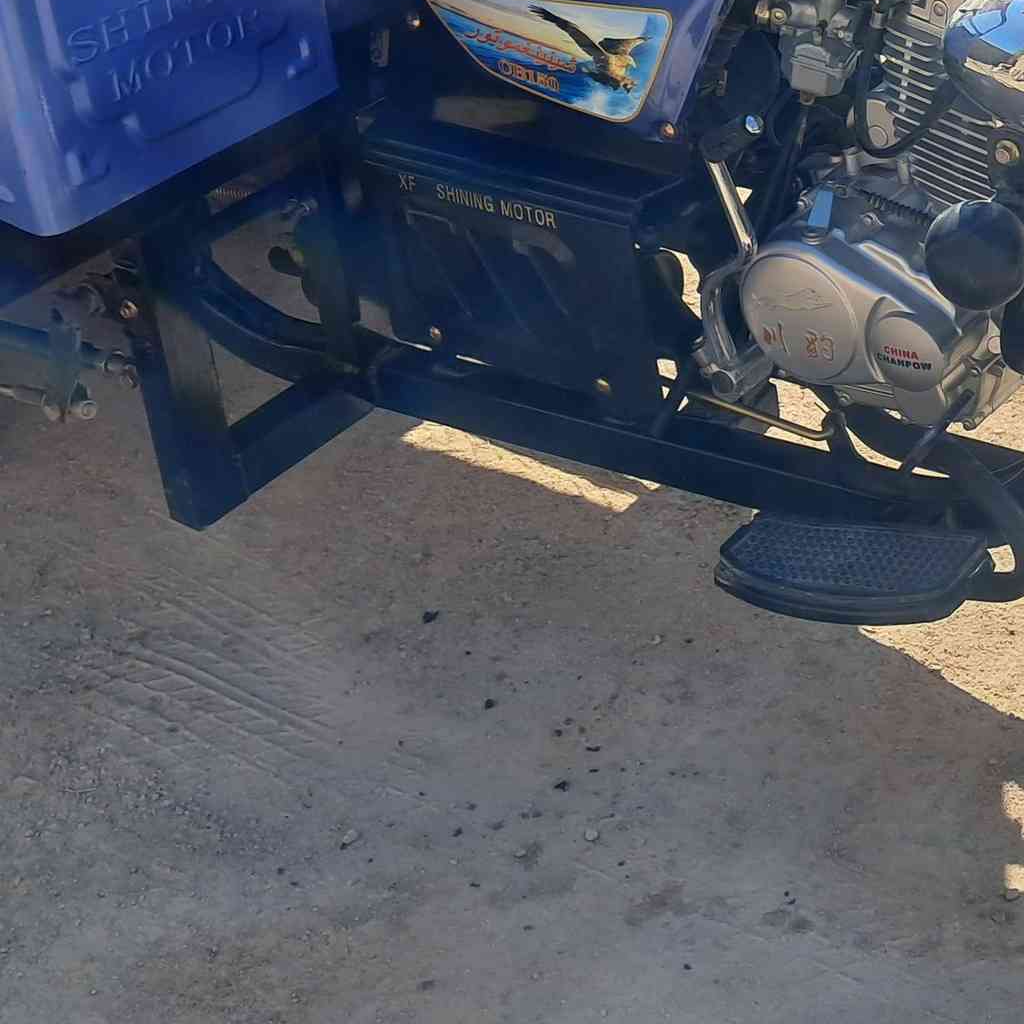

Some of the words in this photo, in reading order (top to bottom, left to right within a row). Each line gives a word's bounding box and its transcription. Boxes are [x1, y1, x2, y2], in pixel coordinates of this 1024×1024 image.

[399, 174, 416, 192] XF
[435, 182, 495, 214] SHINING
[500, 199, 557, 229] MOTOR
[876, 351, 933, 371] CHANPOW
[883, 344, 920, 360] CHINA
